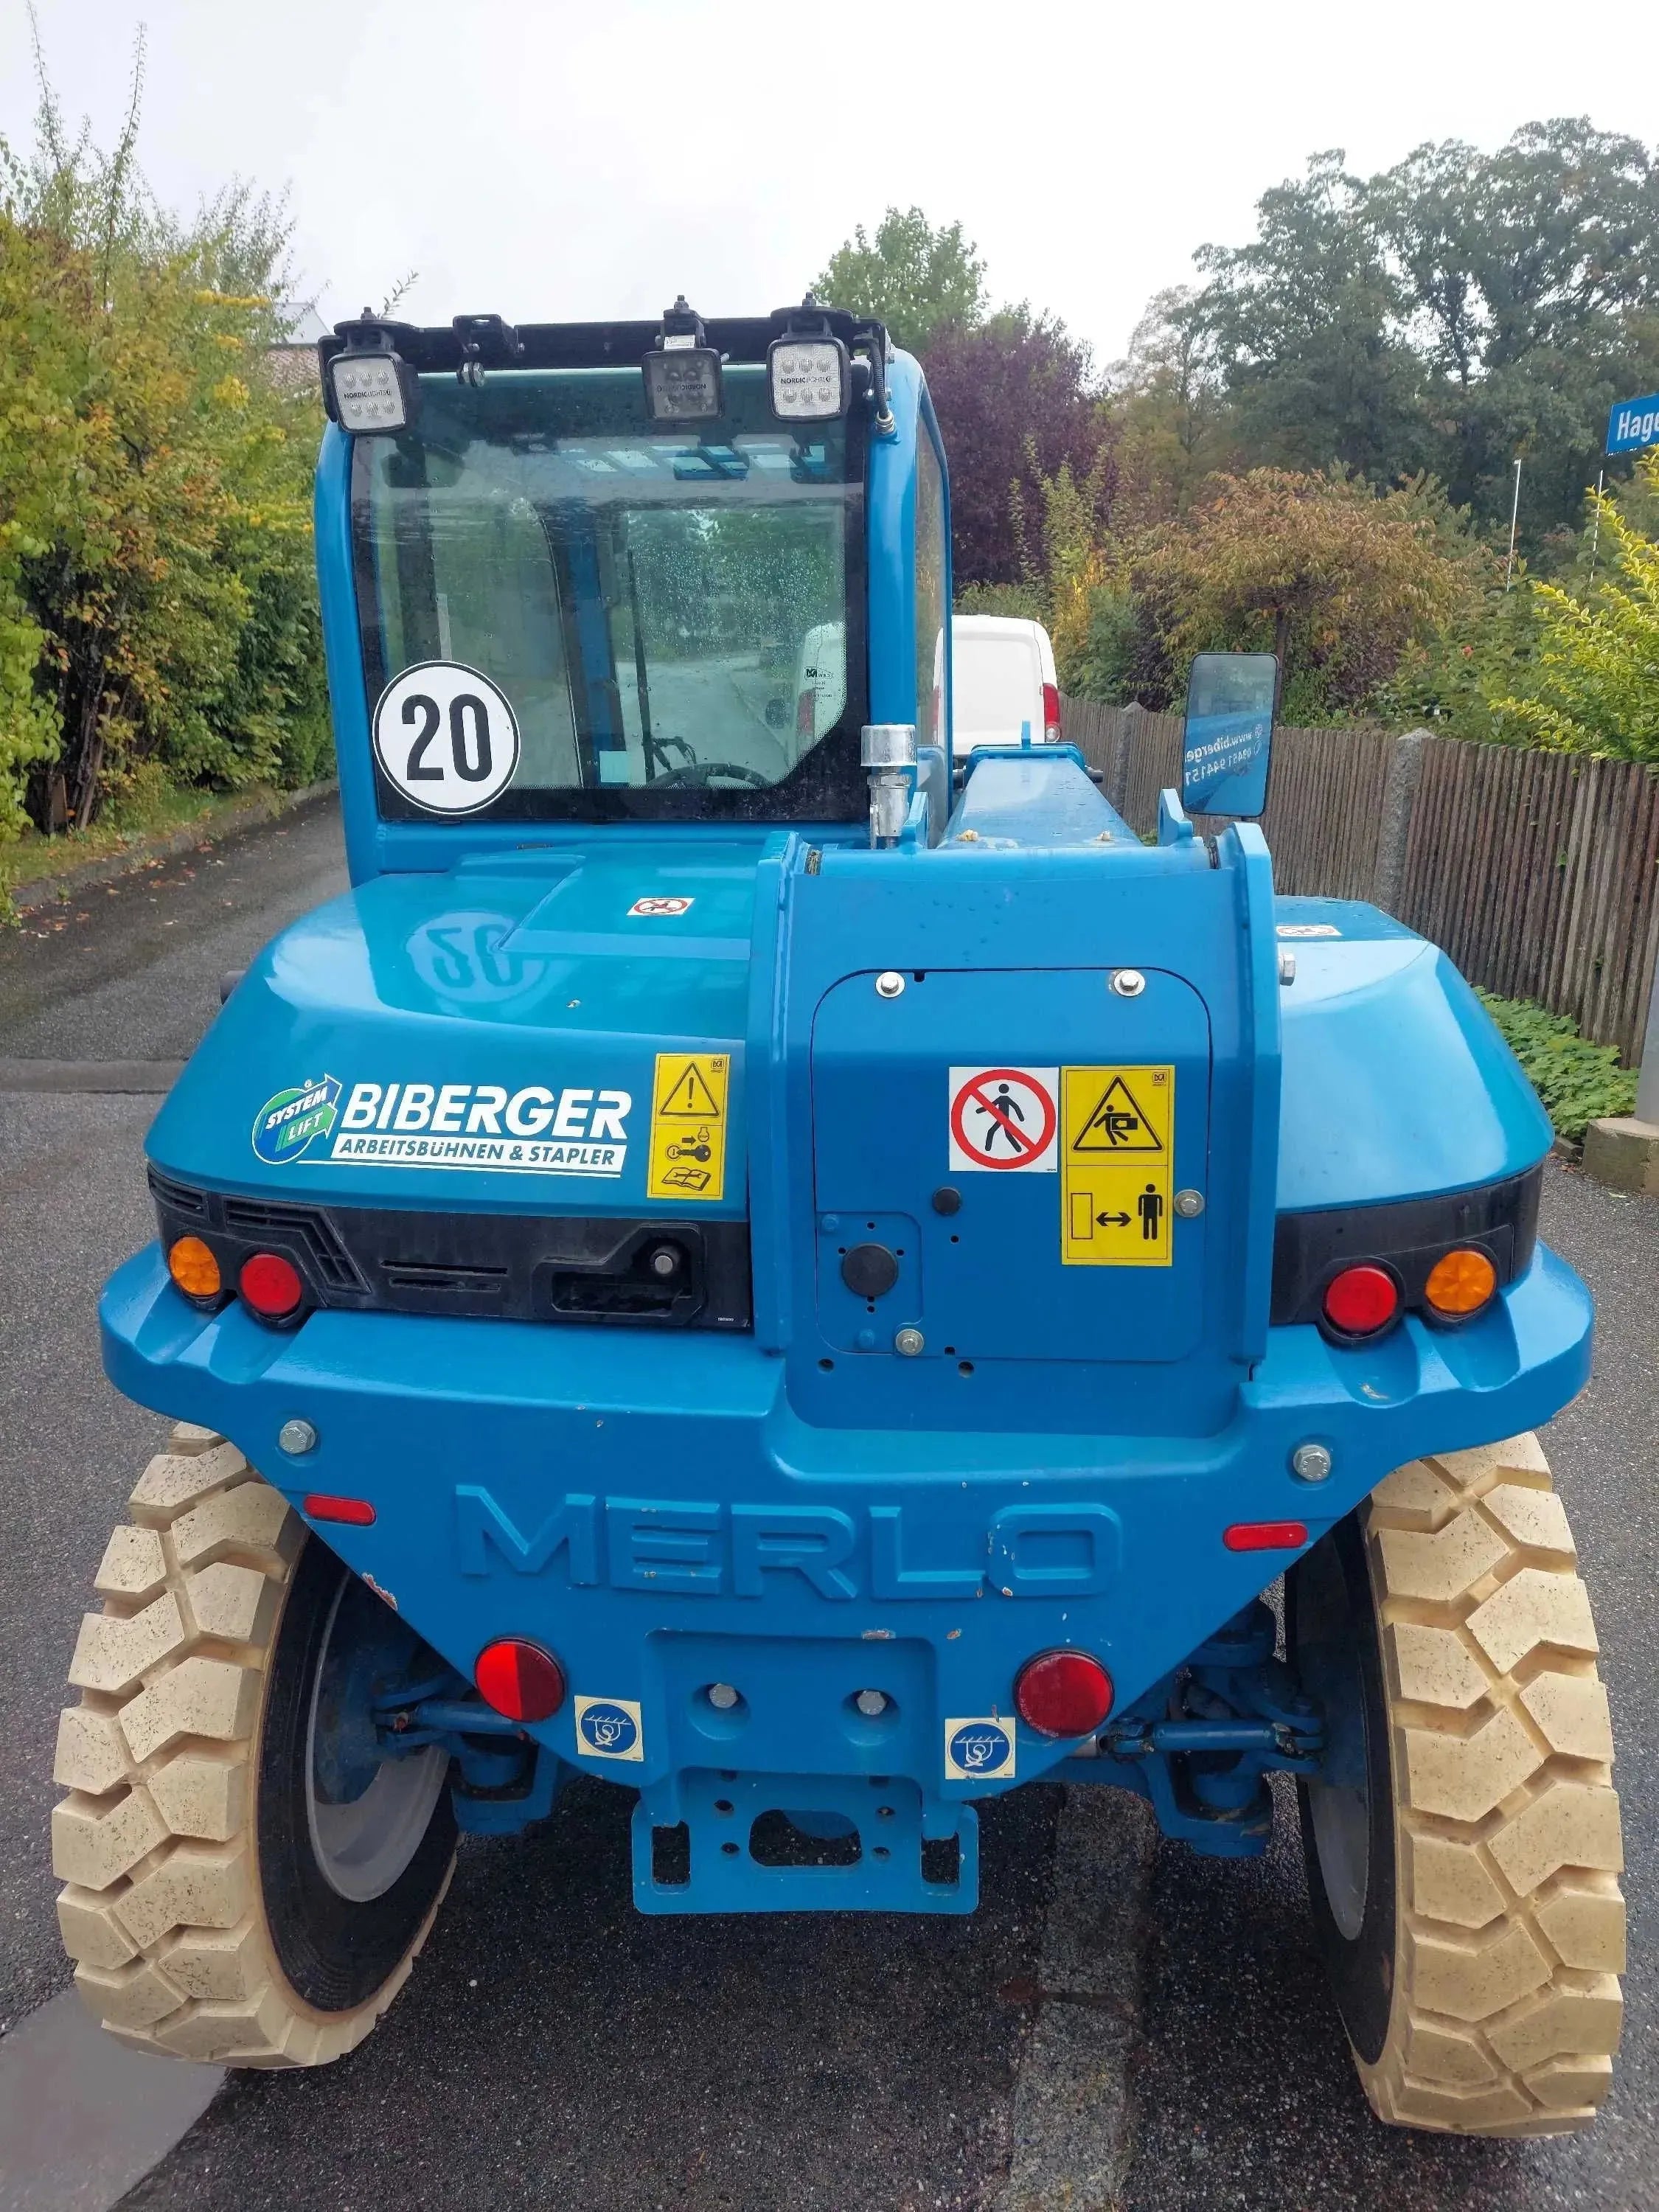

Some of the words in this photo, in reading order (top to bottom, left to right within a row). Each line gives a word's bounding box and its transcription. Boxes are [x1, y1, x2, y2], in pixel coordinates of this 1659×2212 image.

[401, 694, 493, 782] 20
[265, 1085, 328, 1130] SYSTEM
[288, 1110, 324, 1141] LIFT
[340, 1083, 632, 1139] BIBERGER
[339, 1138, 504, 1160] ARBEITSBÜHNEN
[509, 1145, 524, 1161] &
[528, 1145, 615, 1166] STAPLER
[455, 1484, 1122, 1601] MERLO
